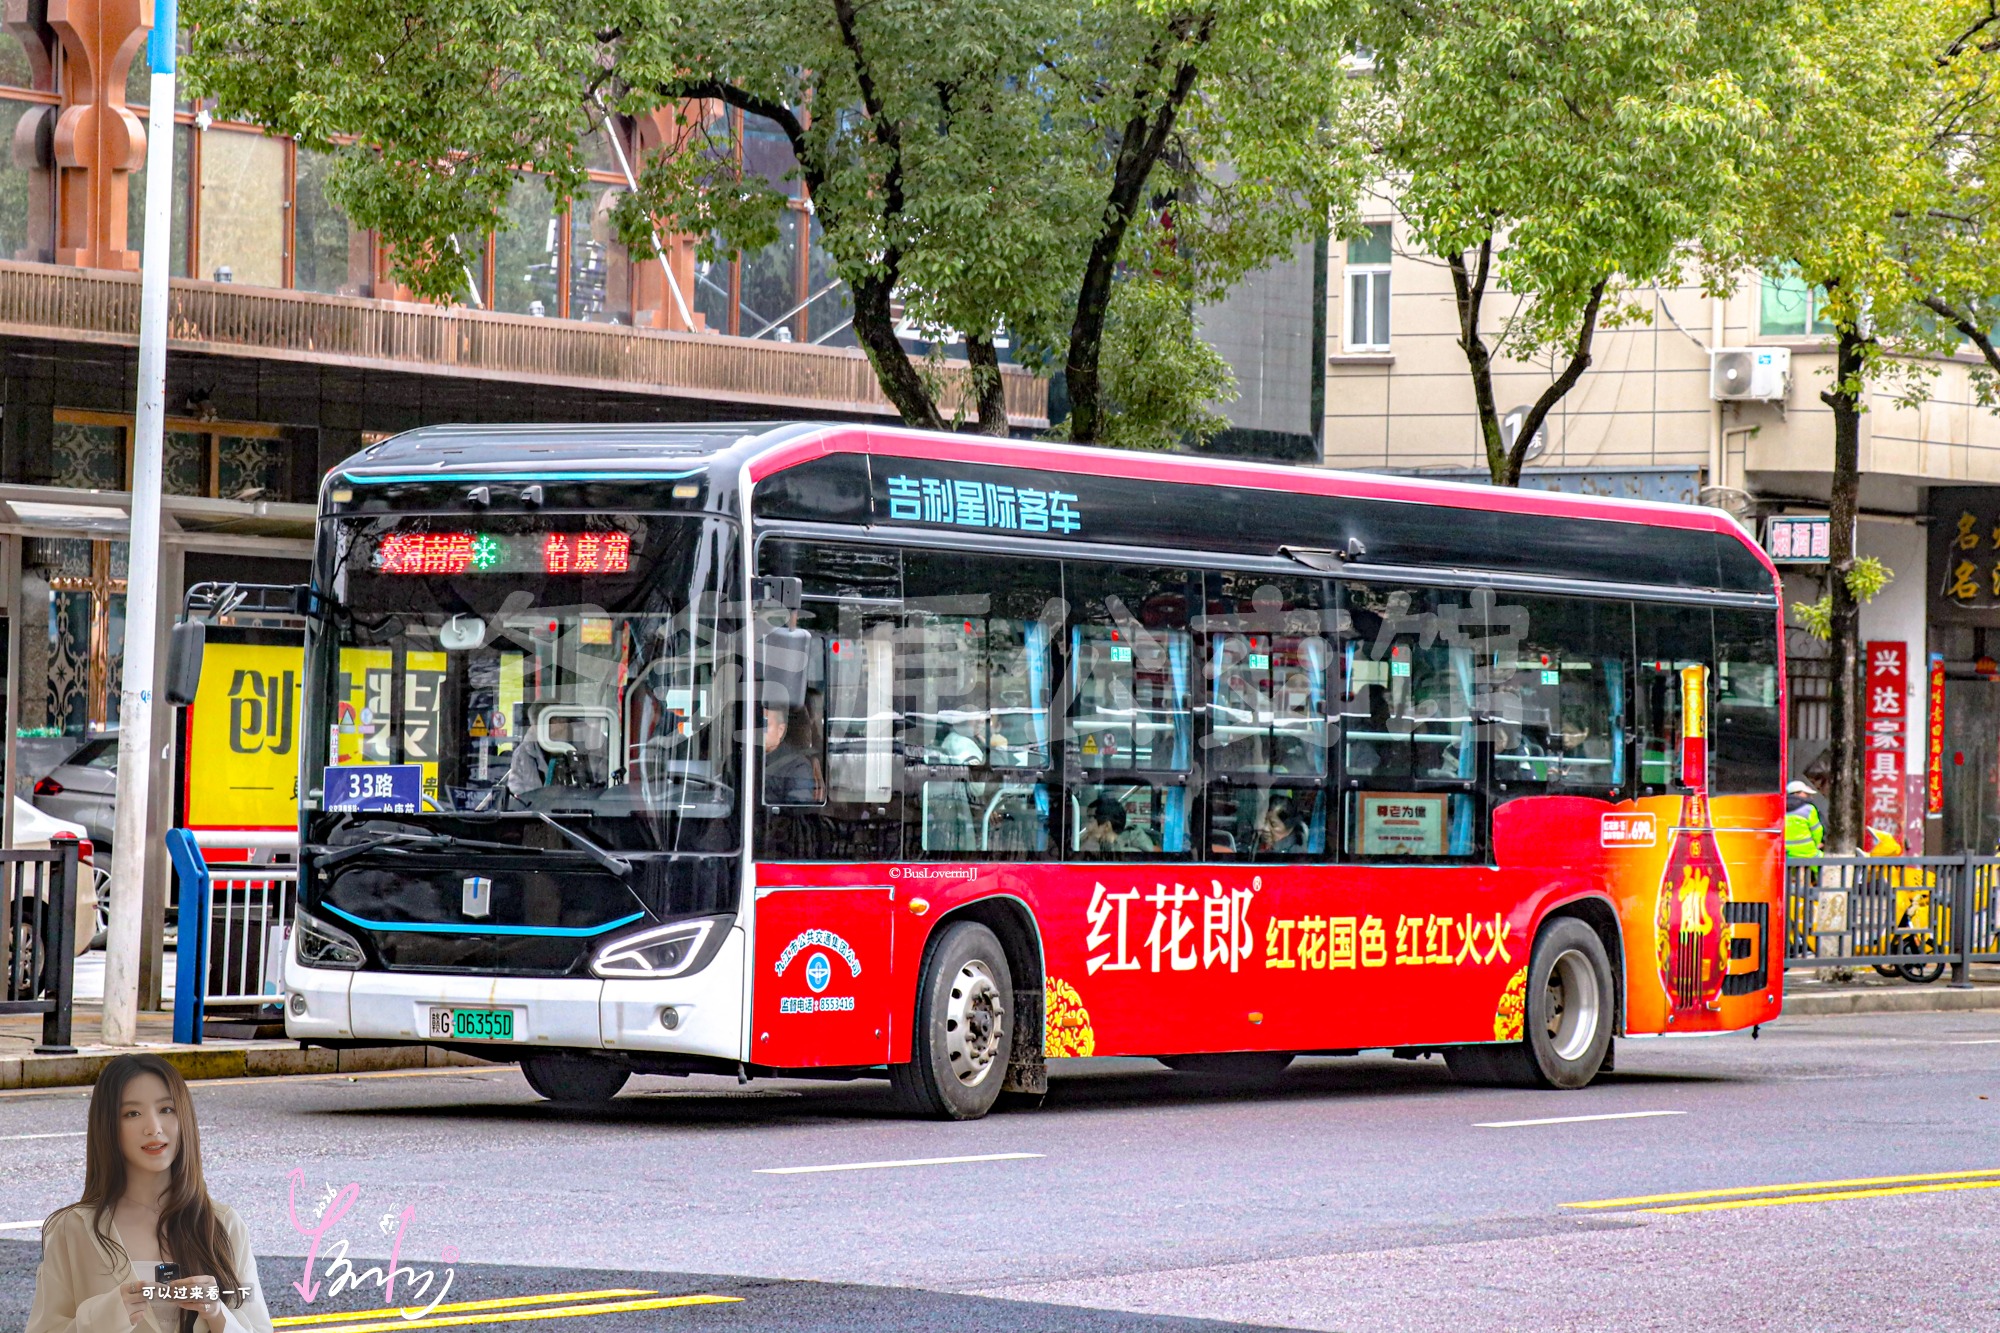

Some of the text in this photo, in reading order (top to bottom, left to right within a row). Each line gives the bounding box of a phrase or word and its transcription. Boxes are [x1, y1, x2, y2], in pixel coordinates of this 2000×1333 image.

[887, 474, 1081, 534] 吉利星际客车
[546, 535, 630, 573] 怡康苑
[349, 773, 393, 798] 33路
[1086, 878, 1512, 977] 红花郎 红花国色 红红火火
[775, 928, 862, 978] 九江市公共交通集团公司
